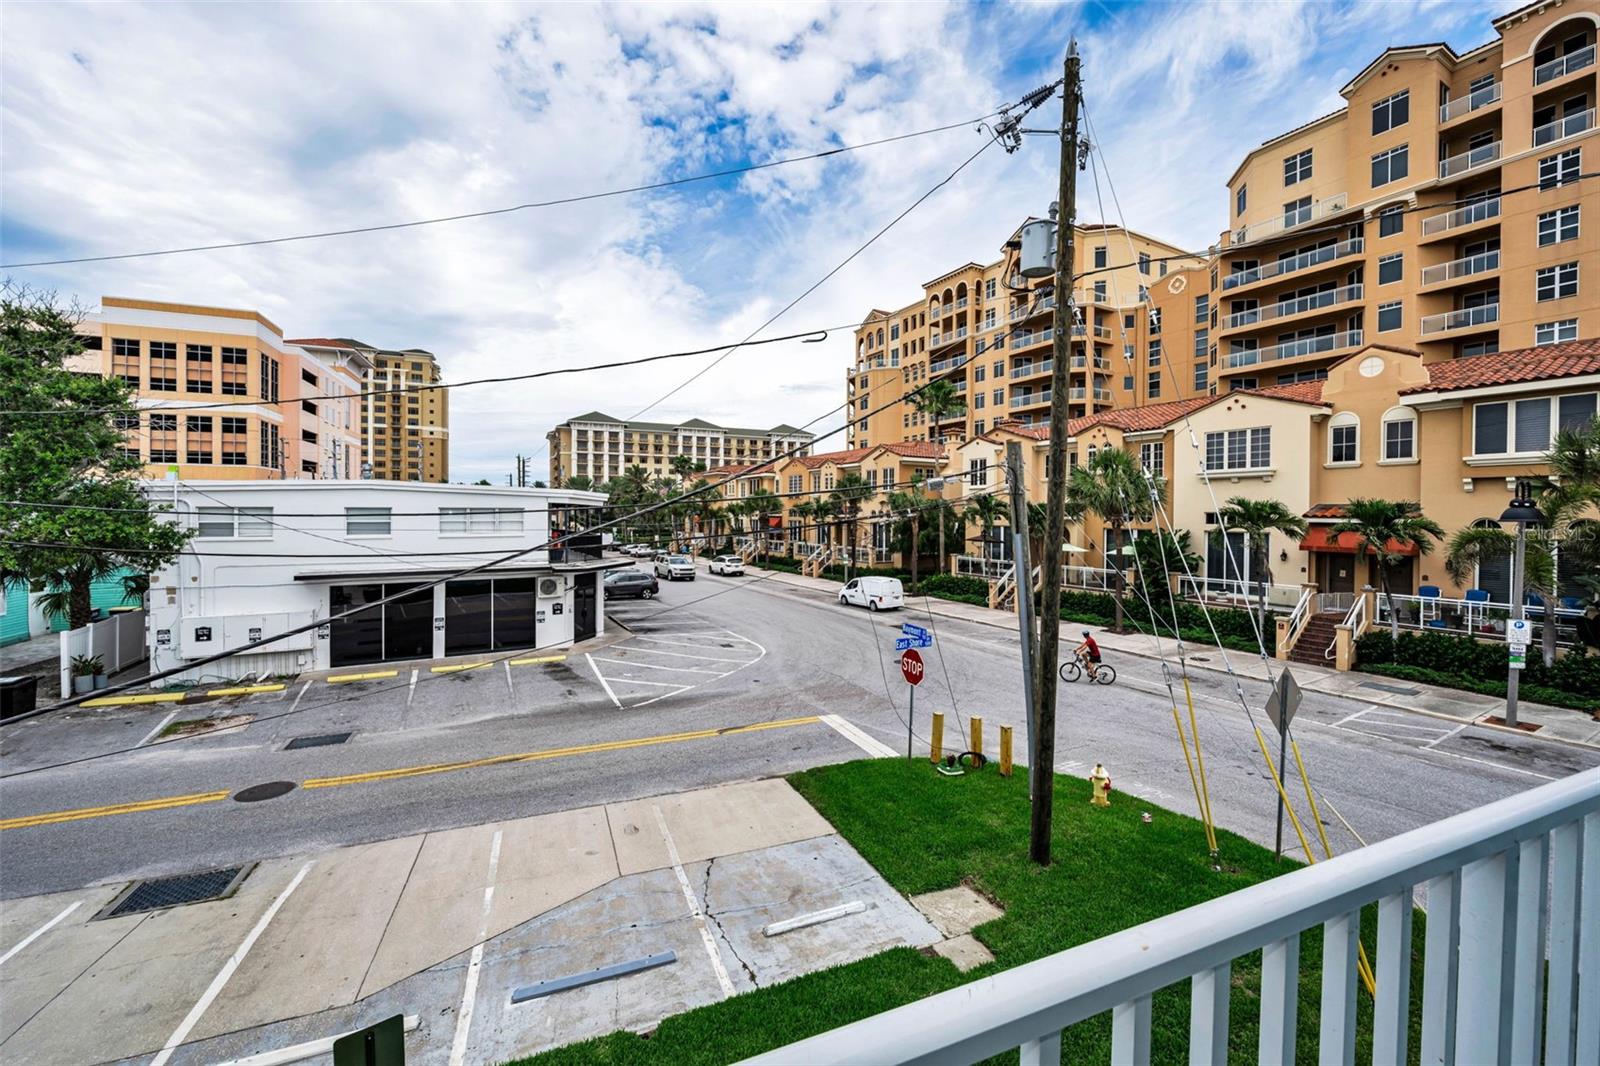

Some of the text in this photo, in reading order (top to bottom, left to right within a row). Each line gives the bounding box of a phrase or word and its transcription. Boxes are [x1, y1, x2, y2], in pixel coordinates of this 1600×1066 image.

[896, 640, 908, 649] East
[909, 639, 923, 648] Shore
[902, 657, 923, 676] STOP
